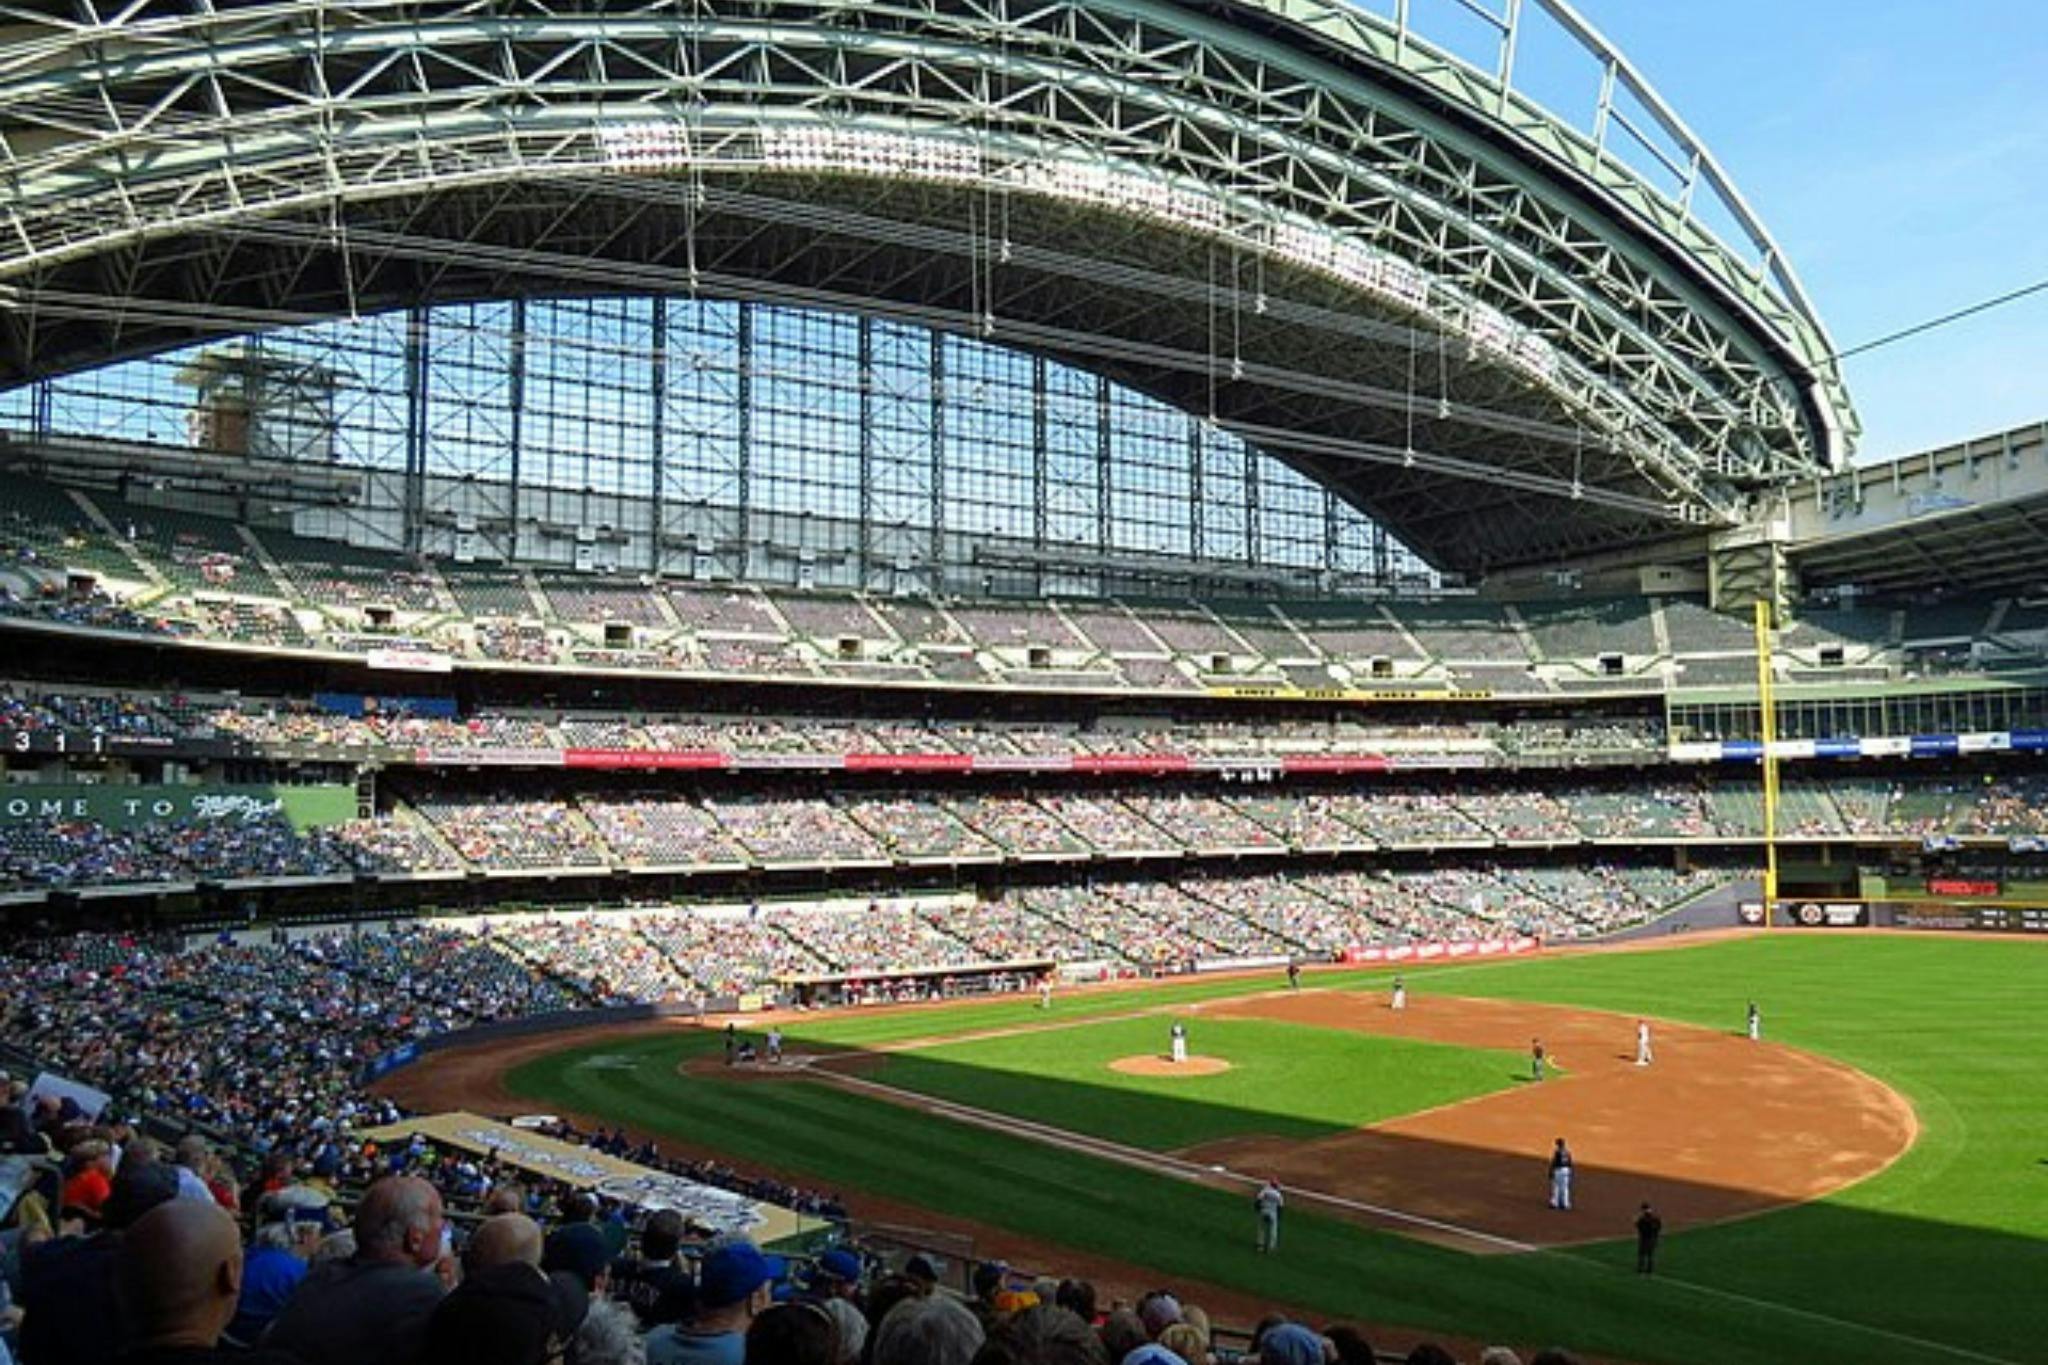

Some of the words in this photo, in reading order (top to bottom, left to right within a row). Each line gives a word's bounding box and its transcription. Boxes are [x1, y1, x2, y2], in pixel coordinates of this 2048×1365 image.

[15, 732, 30, 752] 3
[56, 733, 65, 752] 1
[92, 735, 101, 753] 1
[8, 798, 88, 817] OME
[123, 799, 174, 816] TO
